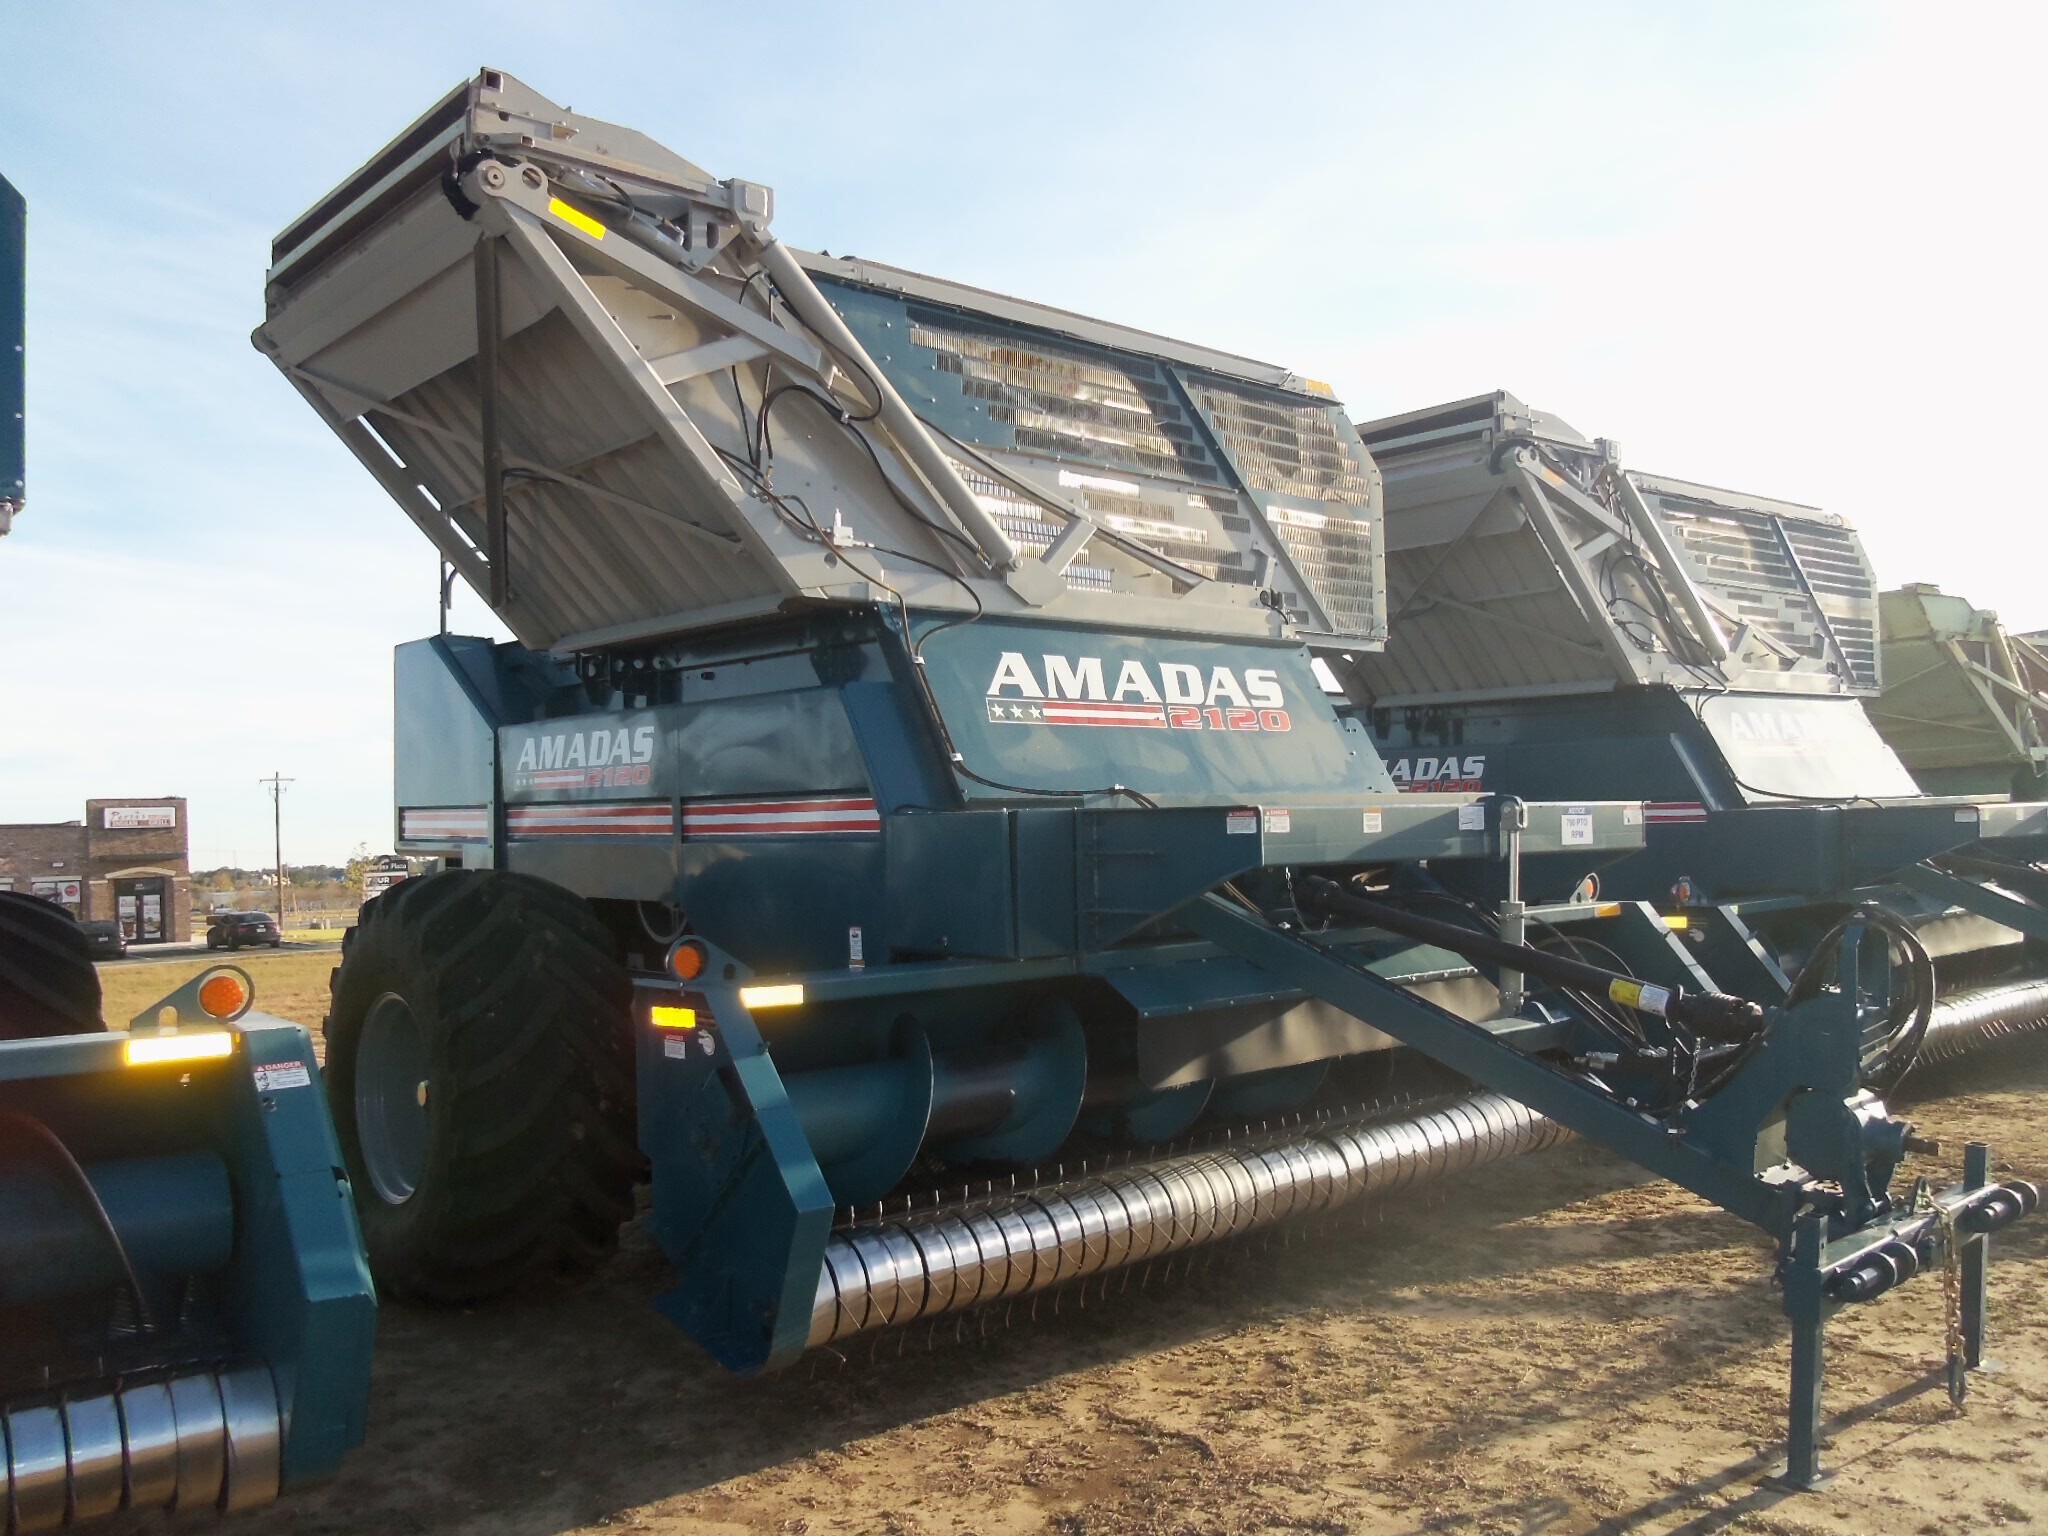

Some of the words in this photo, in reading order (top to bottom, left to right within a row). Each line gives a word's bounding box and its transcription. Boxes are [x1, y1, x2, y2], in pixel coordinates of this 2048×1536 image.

[986, 651, 1285, 709] AMADAS
[1167, 705, 1291, 733] 2120
[516, 726, 655, 771] AMADAS
[584, 764, 652, 788] 2120
[1410, 779, 1483, 793] 2120
[1567, 807, 1586, 815] NOTICE
[1576, 817, 1588, 826] PTO
[1570, 830, 1584, 839] RPM
[264, 1060, 302, 1072] DANGER
